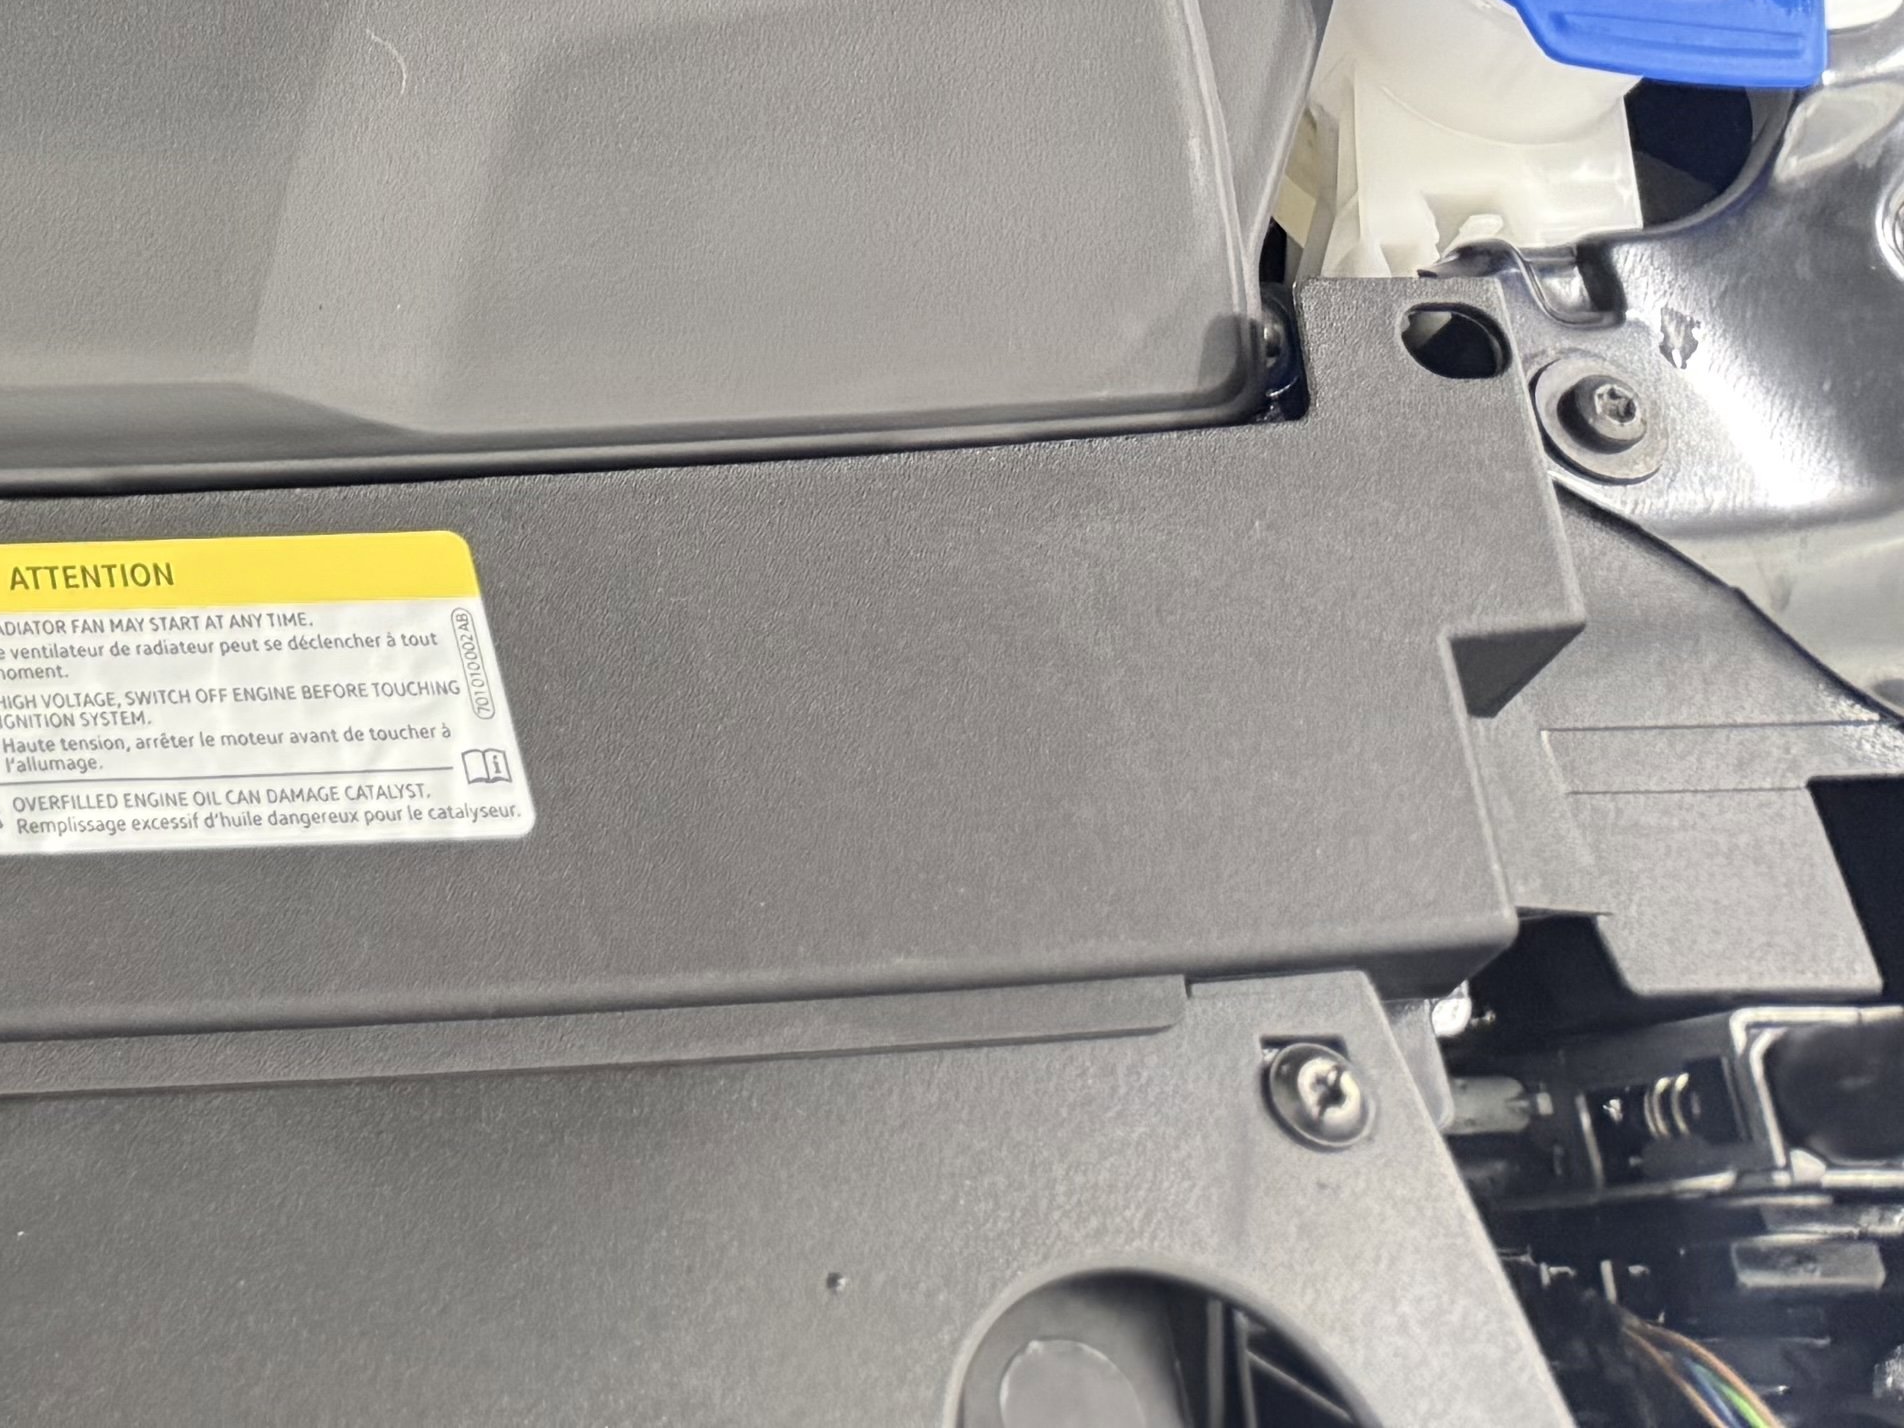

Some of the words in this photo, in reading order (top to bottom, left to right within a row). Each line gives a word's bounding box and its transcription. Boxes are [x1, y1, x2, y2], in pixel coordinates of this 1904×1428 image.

[10, 562, 174, 590] ATTENTION
[71, 619, 105, 634] FAN
[109, 617, 144, 633] MAY
[149, 615, 199, 632] START
[205, 614, 223, 630] AT
[229, 613, 262, 629] ANY
[266, 612, 313, 628] TIME.
[10, 643, 104, 660] ventilateur
[109, 641, 130, 657] de
[136, 639, 214, 656] radiateur
[219, 639, 260, 656] peut
[263, 639, 282, 652] se
[287, 633, 381, 651] déclencher
[386, 632, 396, 648] à
[400, 633, 438, 647] tout
[40, 692, 122, 709] VOLTAGE,
[124, 689, 191, 706] SWITCH
[195, 688, 227, 704] OFF
[232, 685, 297, 702] ENGINE
[301, 683, 368, 700] BEFORE
[371, 680, 461, 698] TOUCHING
[79, 710, 152, 727] SYSTEM.
[2, 738, 56, 754] Haute
[60, 735, 131, 752] tension,
[136, 732, 194, 750] arrêter
[199, 731, 215, 747] le
[220, 730, 284, 746] moteur
[290, 729, 339, 744] avant
[343, 726, 364, 742] de
[369, 724, 436, 741] toucher
[442, 722, 451, 739] à
[5, 756, 103, 774] l'allumage.
[12, 793, 118, 813] OVERFILLED
[123, 792, 189, 808] ENGINE
[192, 791, 222, 807] OIL
[225, 789, 261, 805] CAN
[266, 786, 340, 804] DAMAGE
[344, 783, 431, 801] CATALYST.
[17, 816, 126, 837] Remplissage
[131, 812, 198, 831] excessif
[204, 811, 262, 829] d'huile
[267, 810, 359, 829] dangereux
[364, 809, 402, 826] pour
[407, 805, 423, 821] le
[428, 803, 521, 823] catalyseur.
